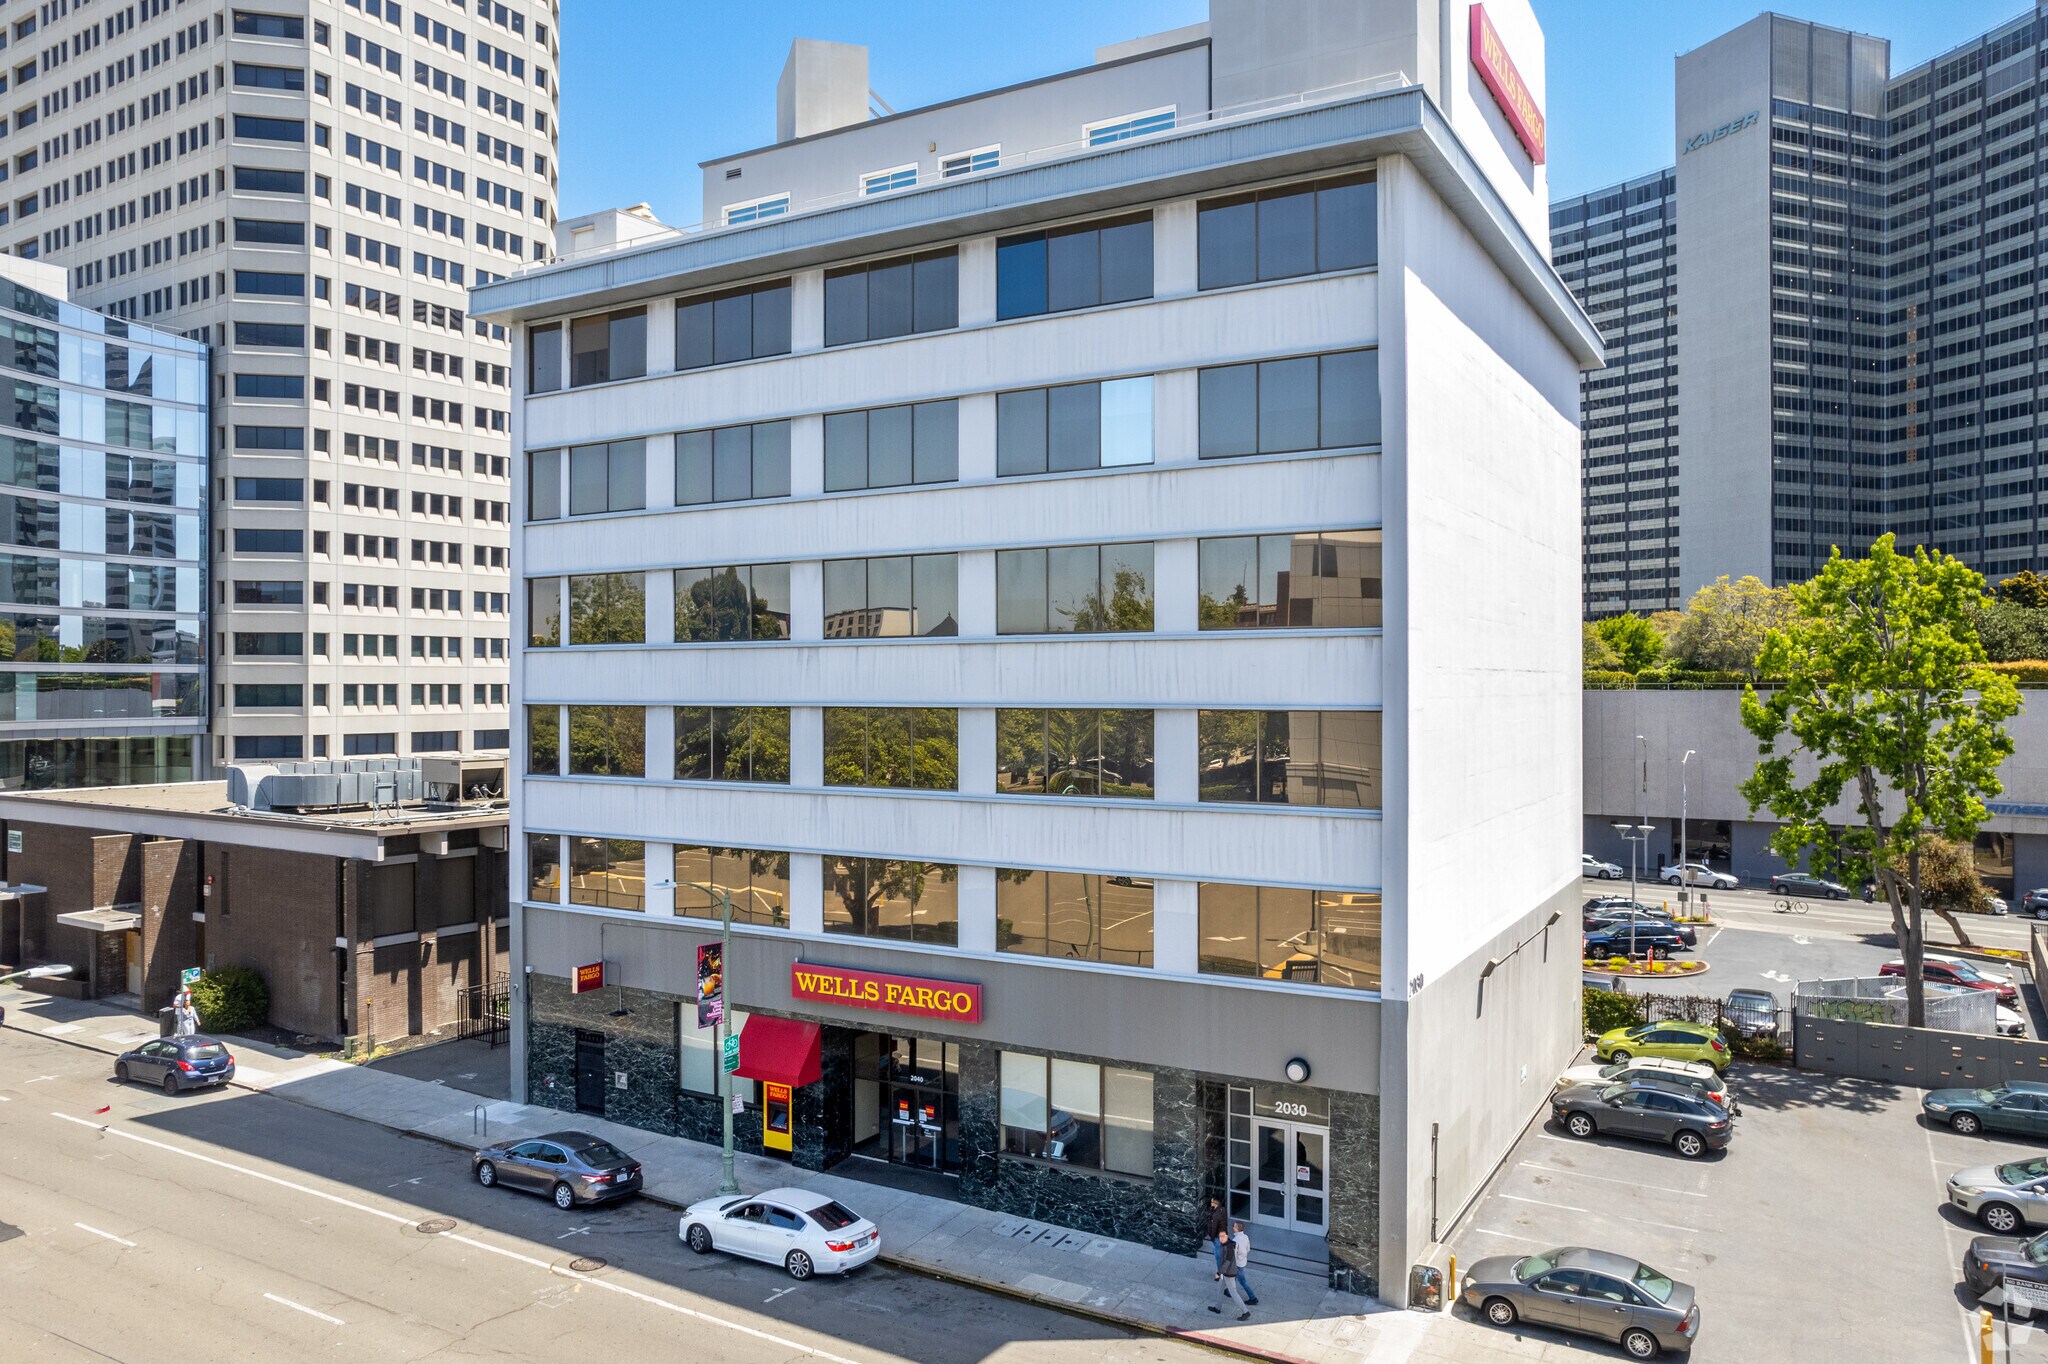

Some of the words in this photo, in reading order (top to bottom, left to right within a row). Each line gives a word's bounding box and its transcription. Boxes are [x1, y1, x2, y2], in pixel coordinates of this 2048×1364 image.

[1482, 20, 1516, 100] WELLS
[1517, 83, 1544, 148] FARGO
[1682, 111, 1759, 156] KAISER
[580, 965, 600, 975] WELLS
[580, 972, 600, 981] FARGO
[794, 971, 879, 1002] WELLS
[885, 983, 973, 1013] FARGO
[910, 1075, 924, 1083] 2040
[769, 1086, 788, 1095] WELLS
[769, 1091, 788, 1100] FARGO
[1274, 1101, 1307, 1117] 2030
